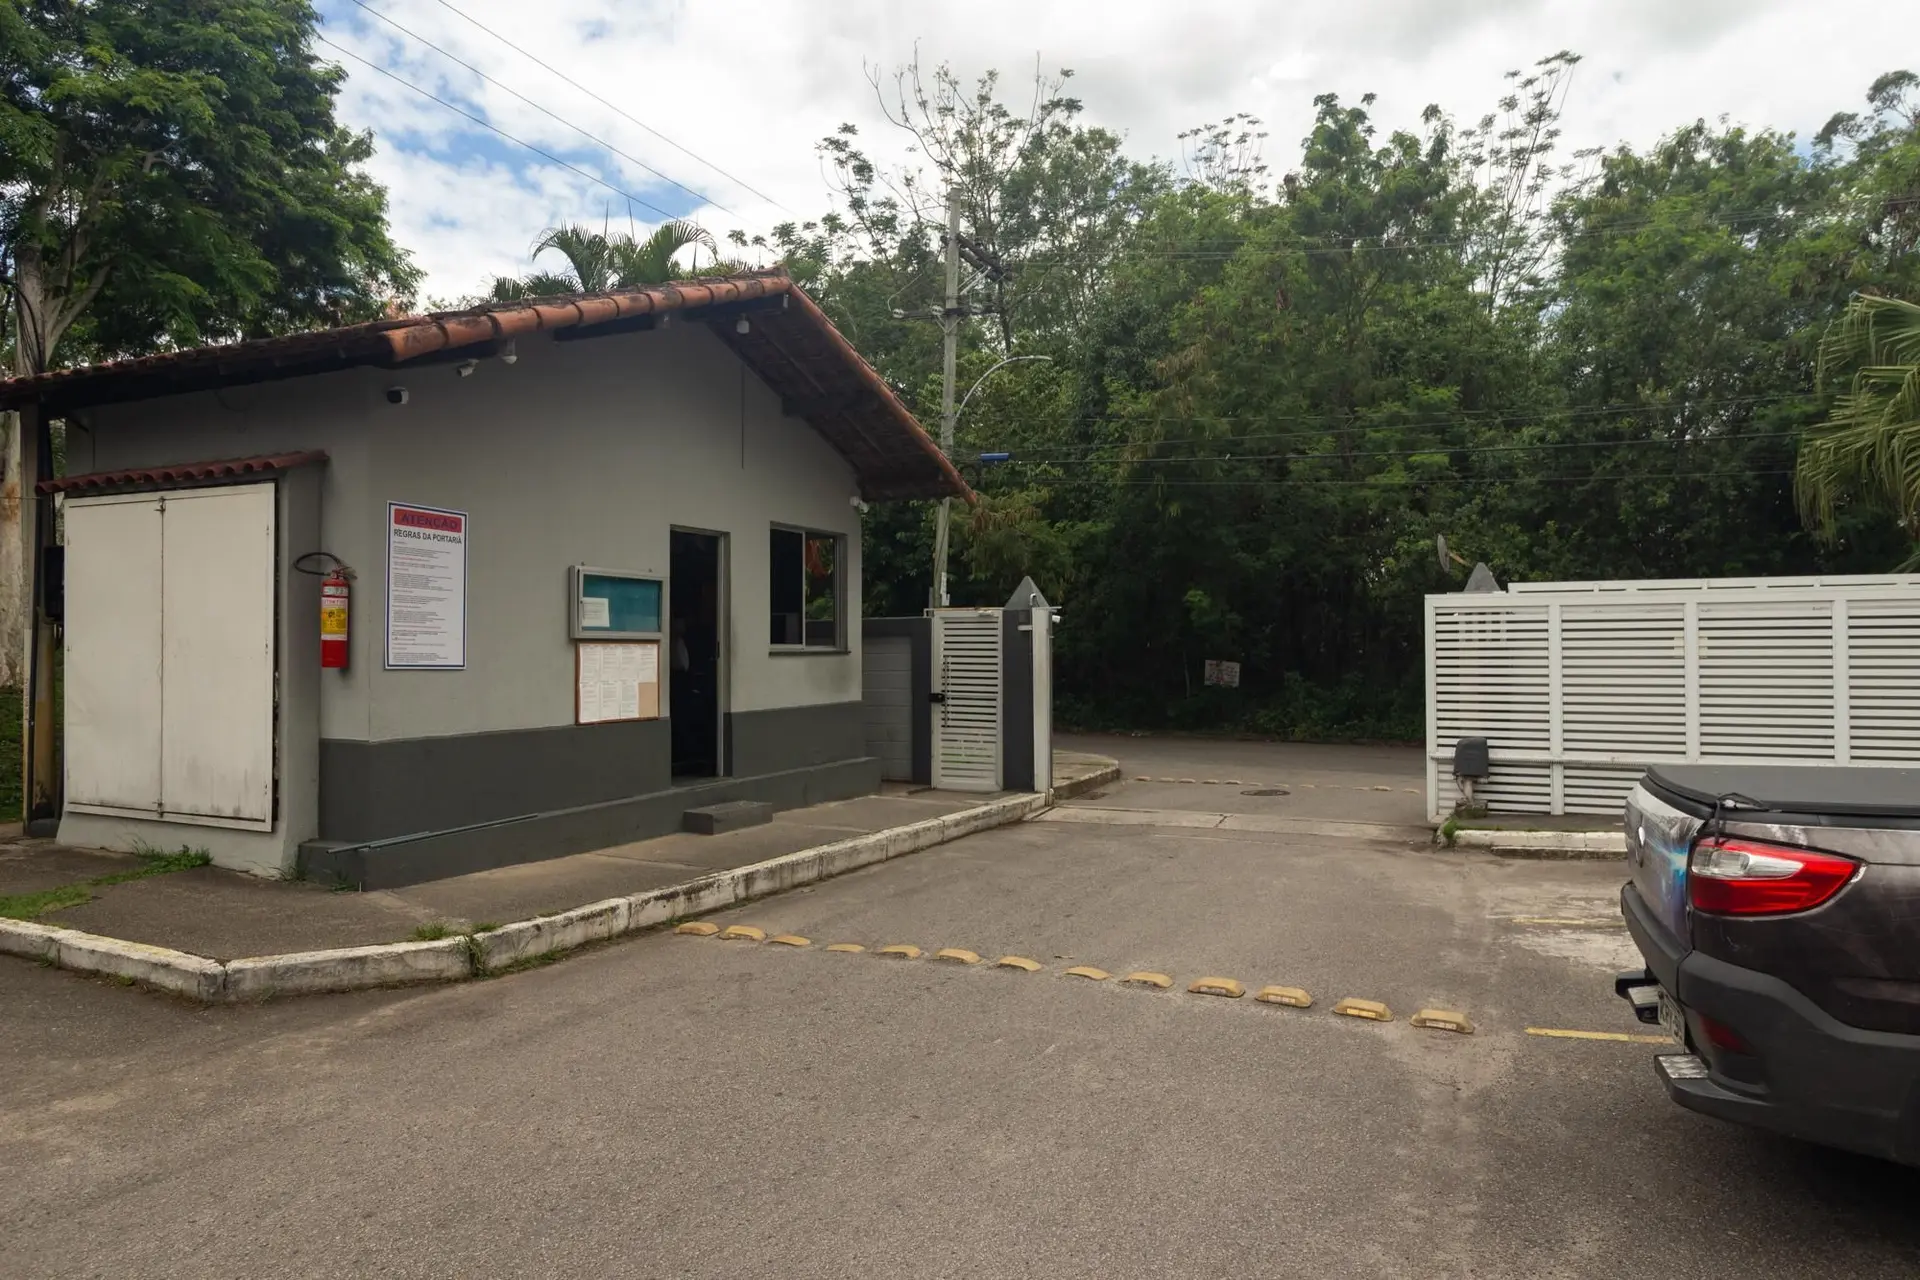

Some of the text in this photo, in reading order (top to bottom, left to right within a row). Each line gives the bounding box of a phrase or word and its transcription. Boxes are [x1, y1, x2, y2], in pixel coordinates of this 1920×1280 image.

[402, 512, 457, 530] ATENÇÃO
[394, 529, 462, 545] REGRAS DA PORTARIA
